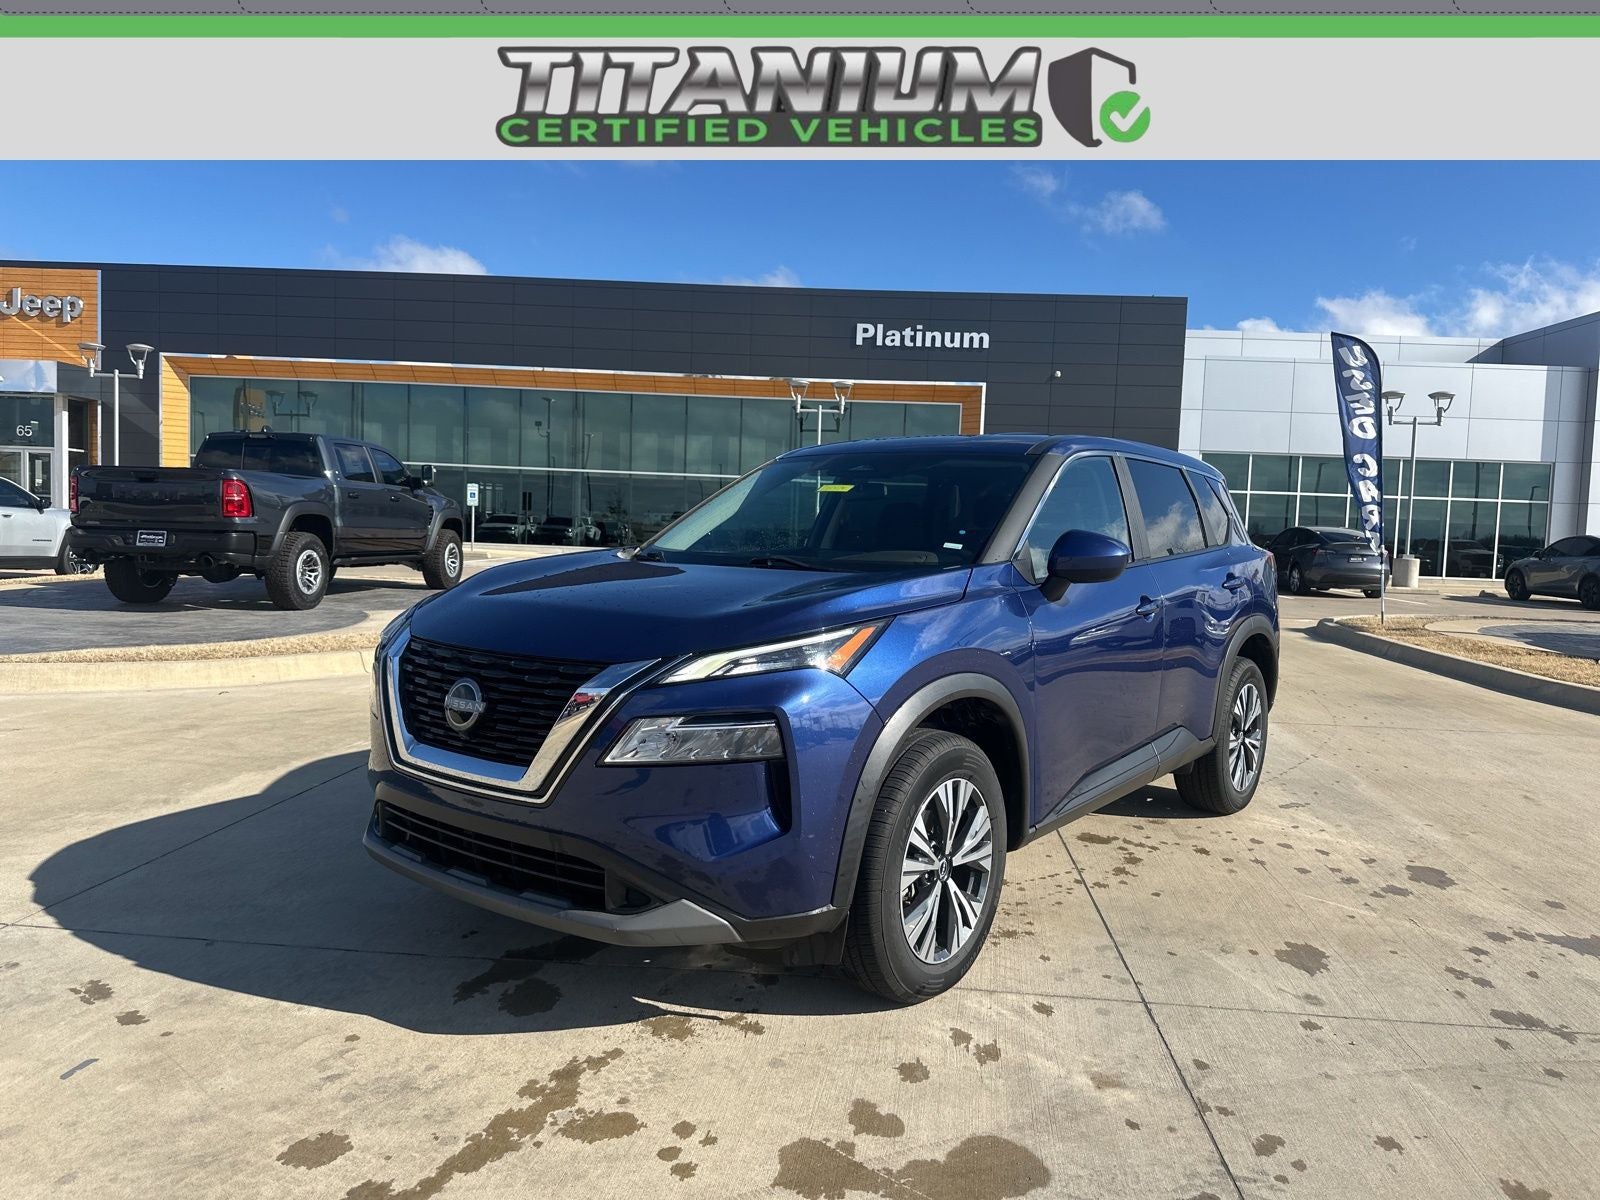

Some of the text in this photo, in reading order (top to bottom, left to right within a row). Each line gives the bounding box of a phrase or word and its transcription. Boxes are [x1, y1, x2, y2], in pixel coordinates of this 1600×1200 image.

[0, 287, 84, 323] Jeep
[855, 322, 990, 349] Platinum
[16, 424, 33, 437] 65
